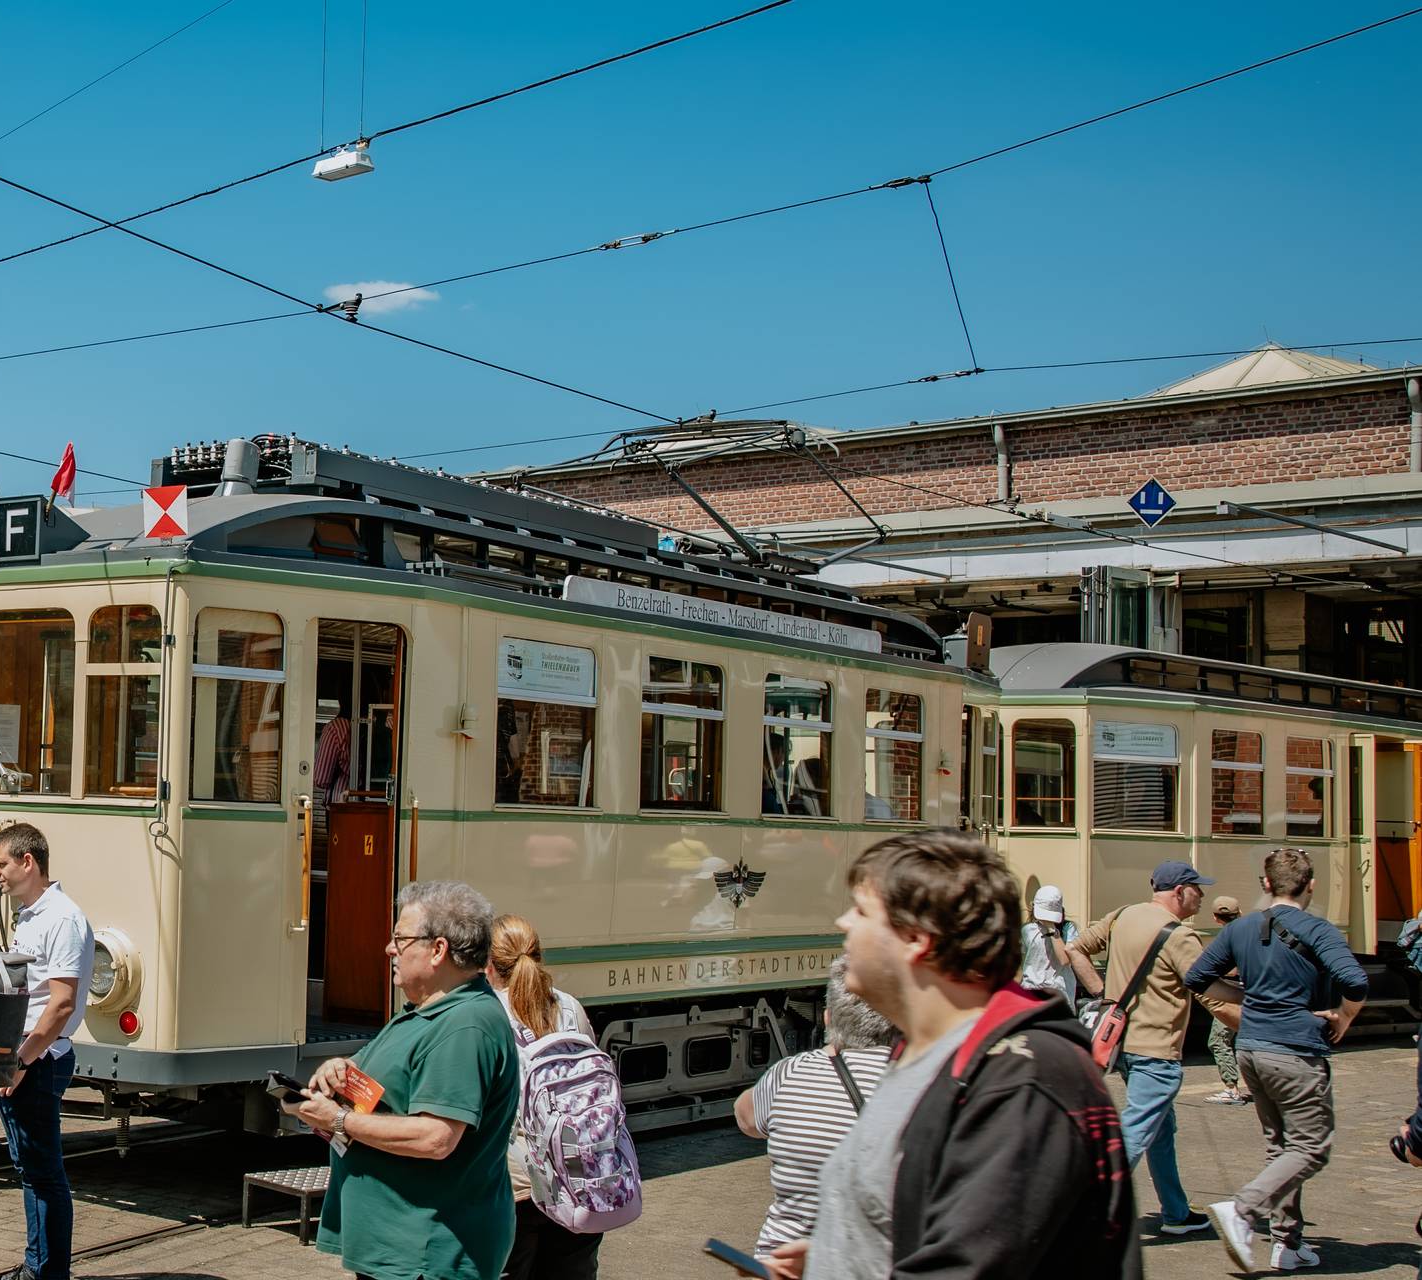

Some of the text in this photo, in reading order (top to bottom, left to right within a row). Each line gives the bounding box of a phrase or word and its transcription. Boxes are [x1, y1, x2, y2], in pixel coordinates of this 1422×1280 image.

[6, 508, 29, 552] F
[617, 588, 672, 616] Benzelrath
[681, 598, 719, 623] Frechen
[728, 607, 770, 632] Marsdorf
[777, 616, 820, 641] Lindenthal
[828, 626, 848, 646] Köln
[608, 963, 688, 987] BAHNEN
[696, 960, 730, 979] DER
[738, 956, 791, 976] STADT
